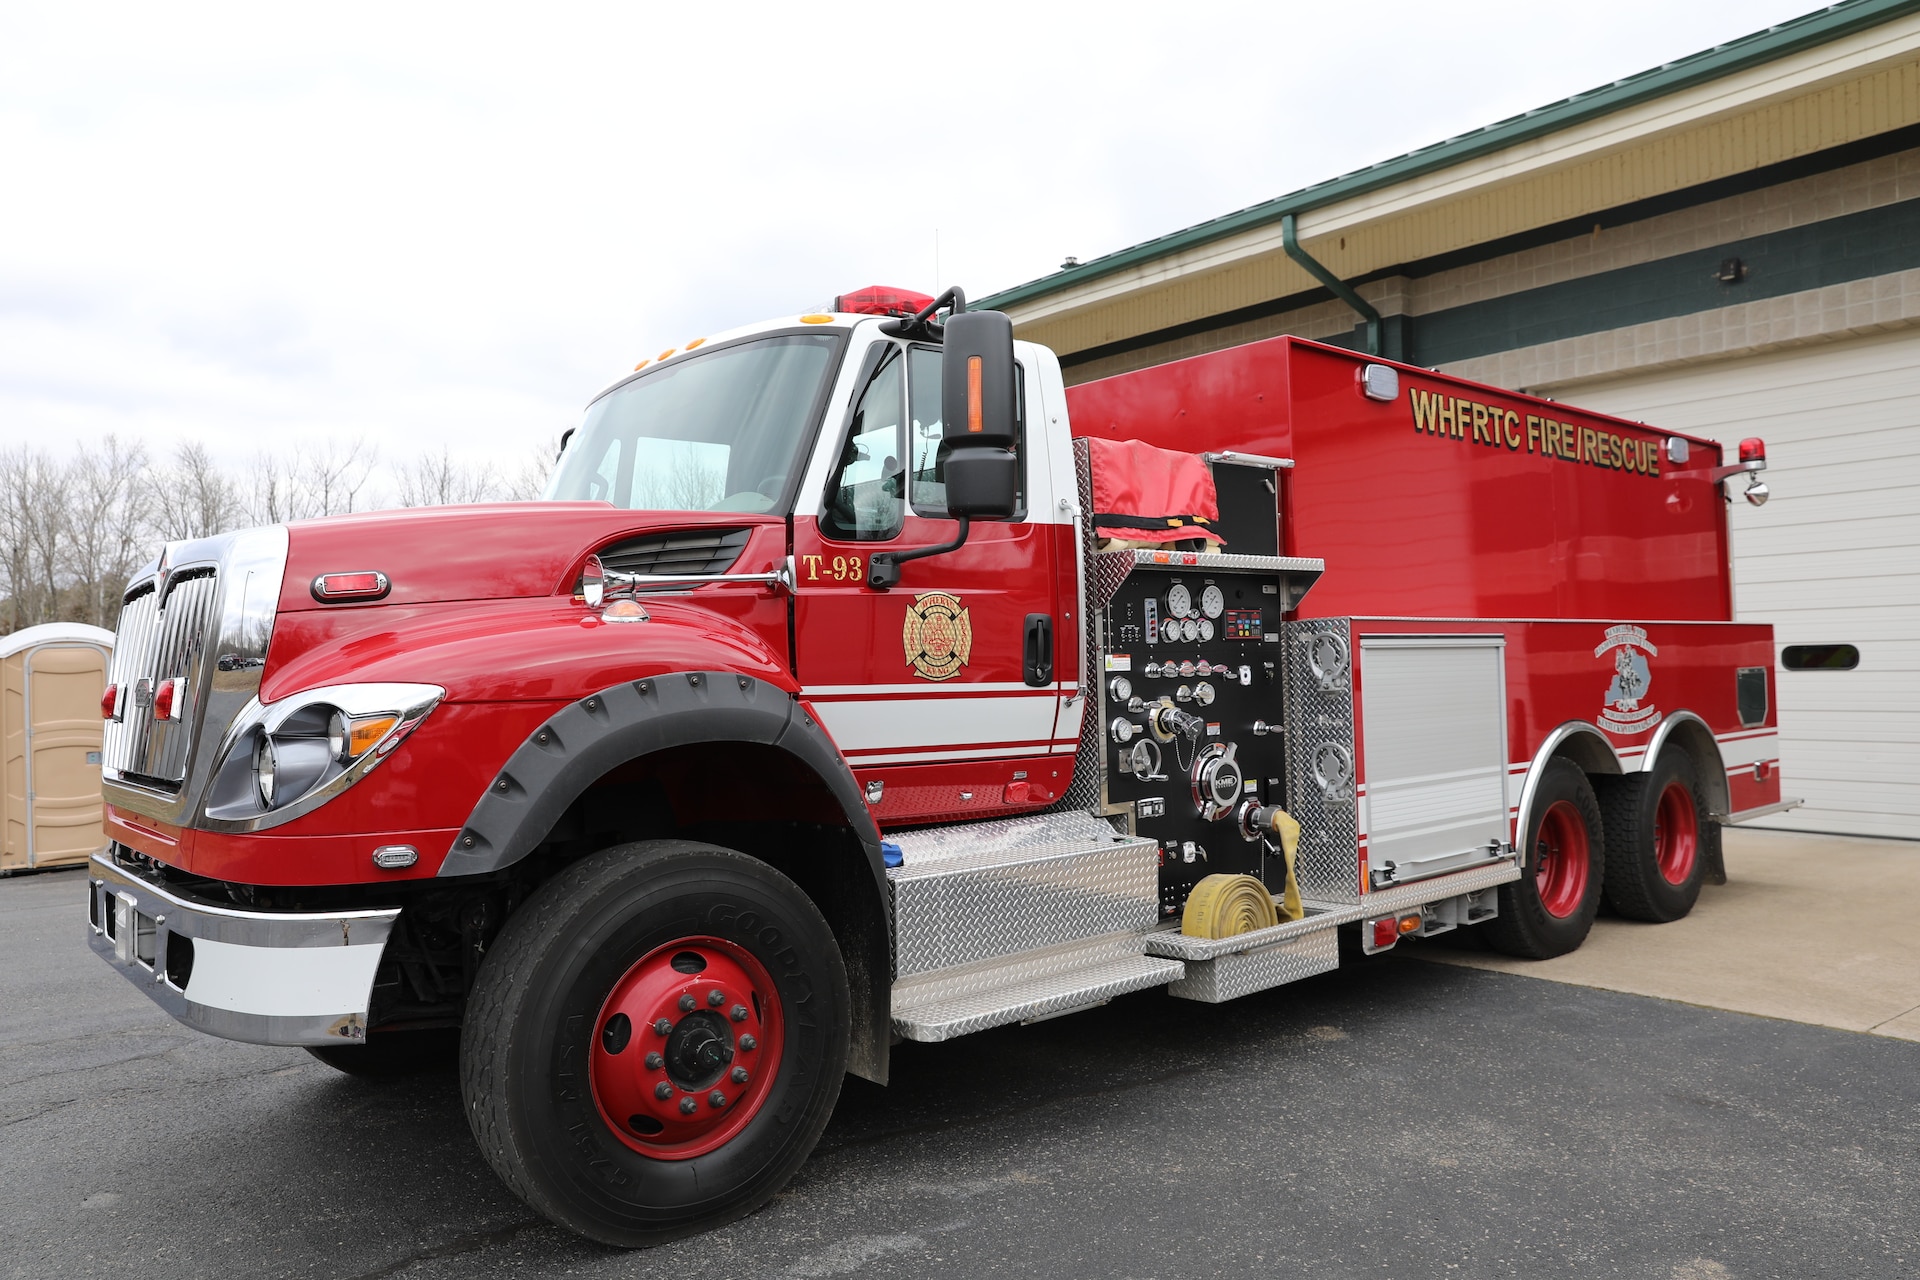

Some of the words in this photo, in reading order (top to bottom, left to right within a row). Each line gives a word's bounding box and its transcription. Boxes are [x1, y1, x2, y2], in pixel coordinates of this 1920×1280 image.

[1410, 388, 1520, 449] WHFRTC
[1526, 414, 1660, 477] FIRE/RESCUE
[802, 555, 863, 582] T-93
[909, 619, 917, 651] FIRE
[958, 615, 967, 657] RESCUE
[1216, 777, 1234, 786] KME
[706, 903, 817, 1125] GOODYEAR
